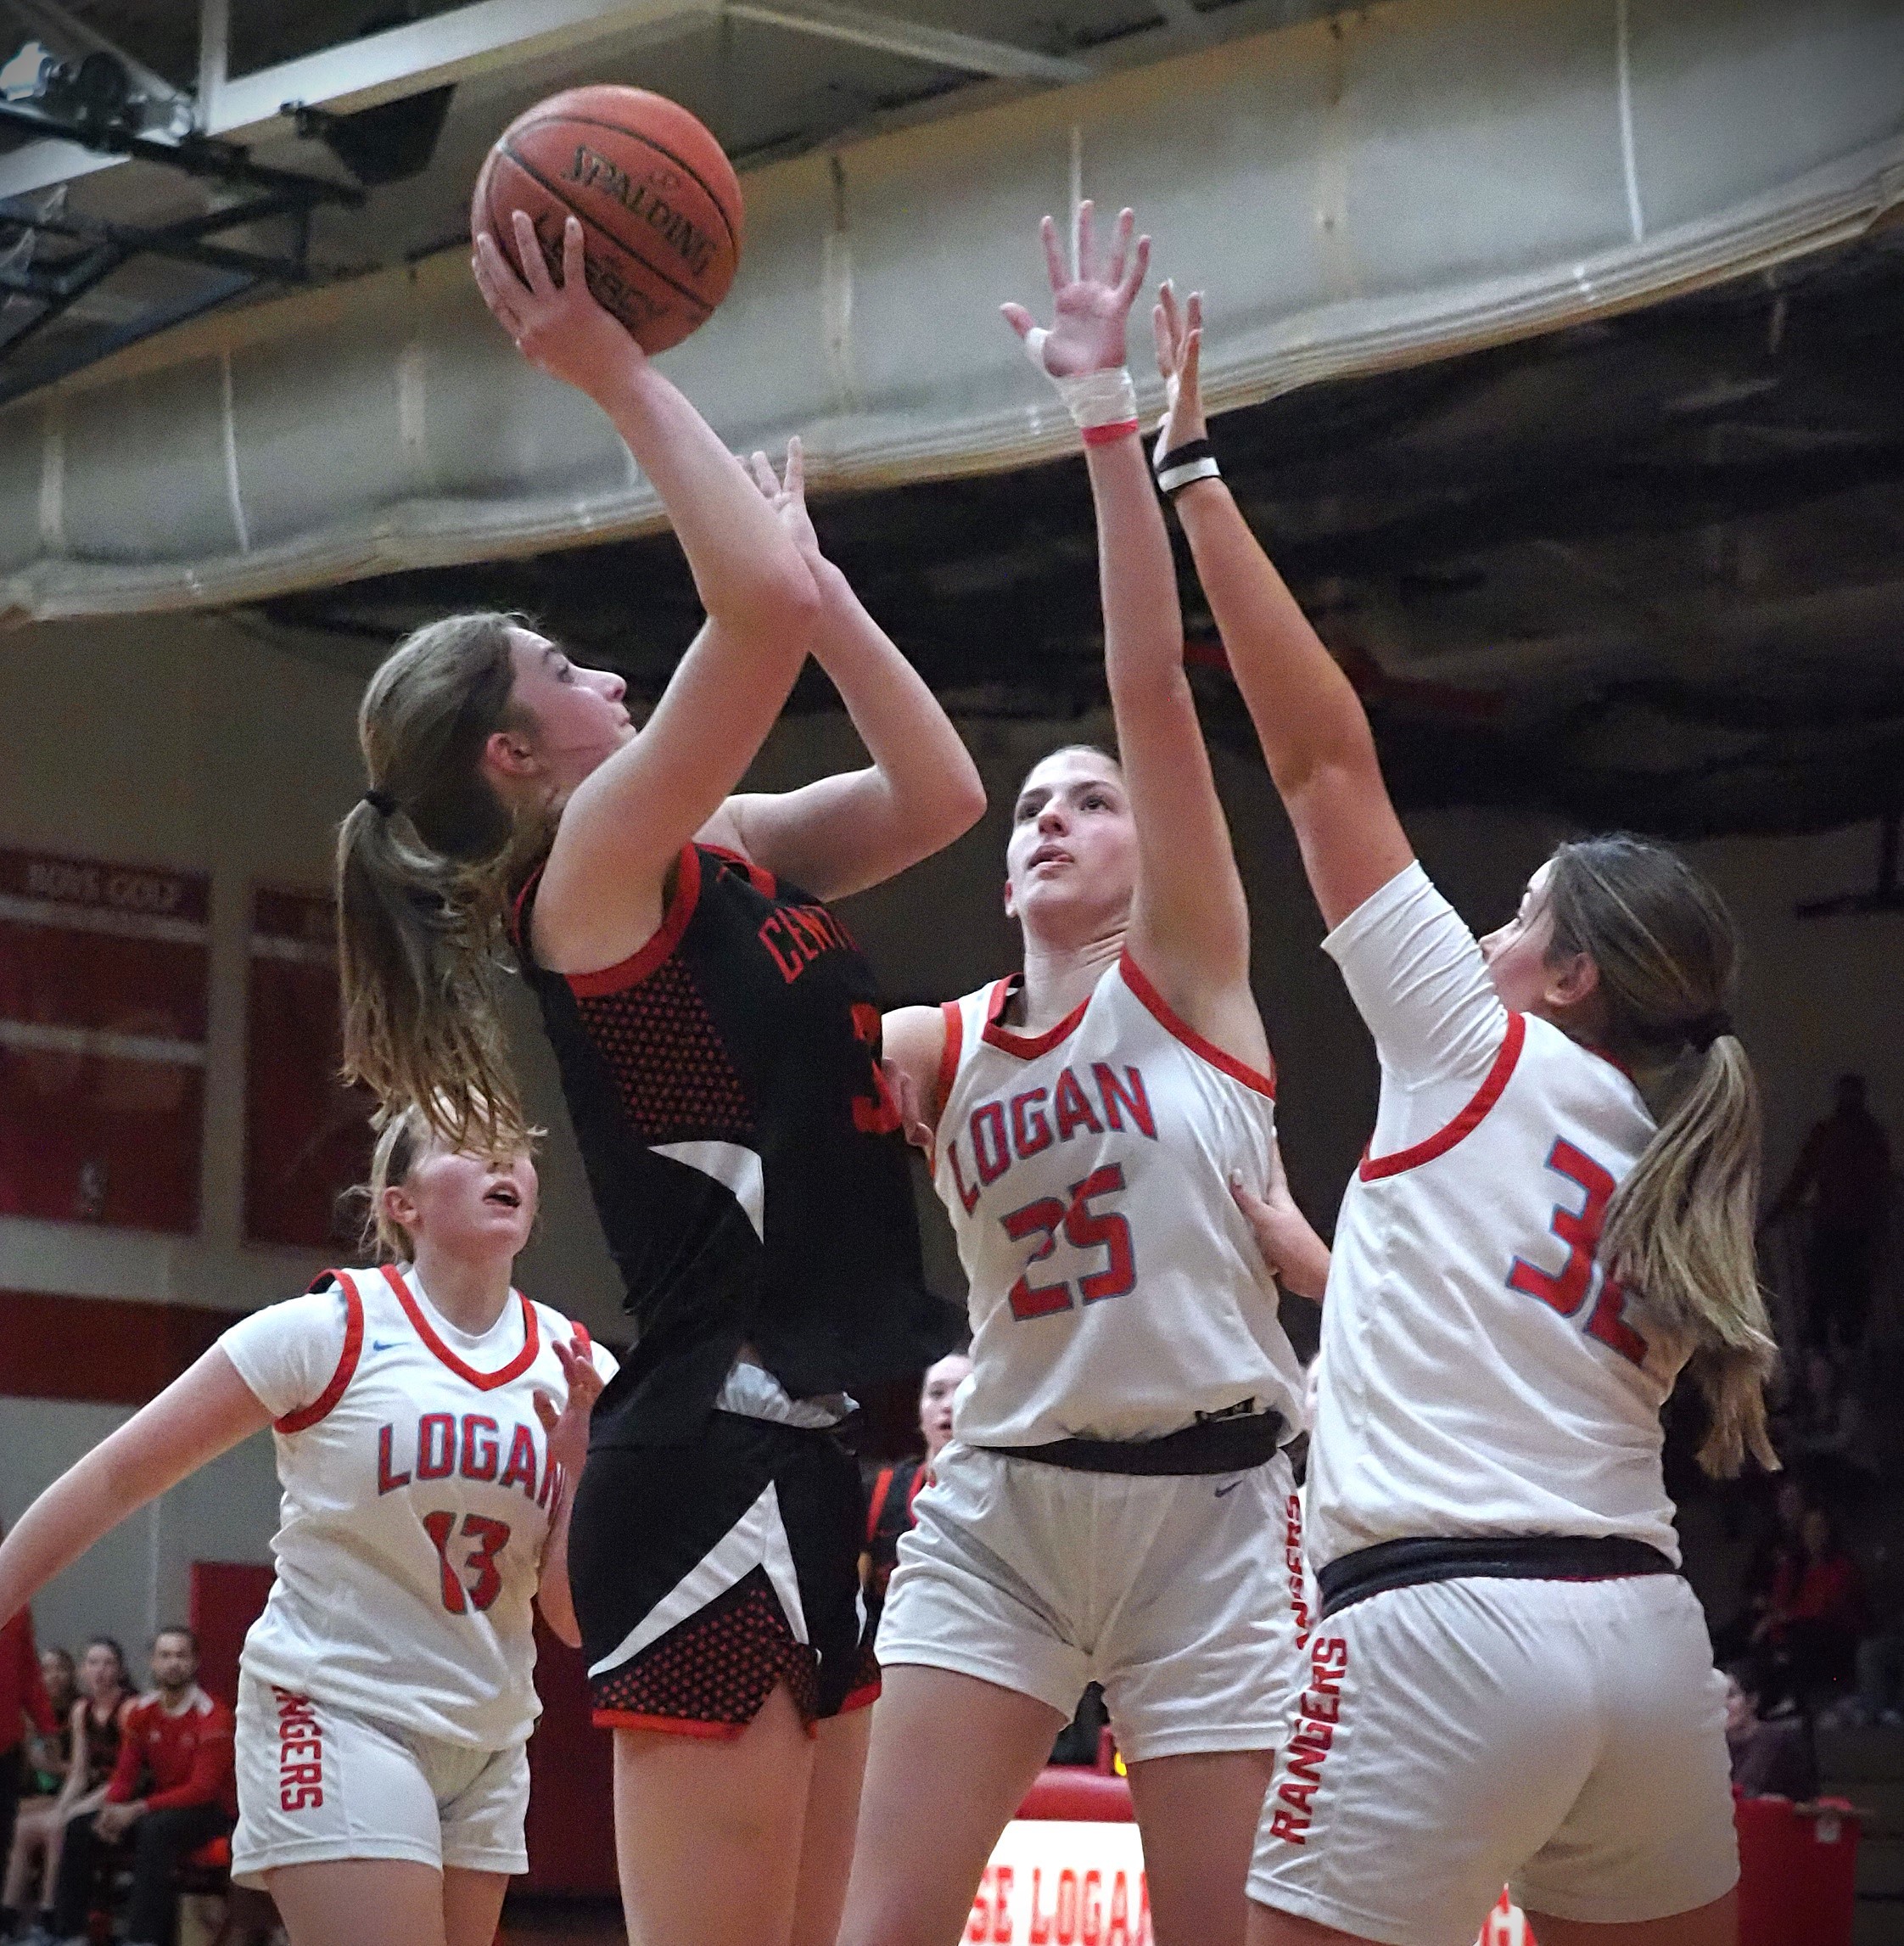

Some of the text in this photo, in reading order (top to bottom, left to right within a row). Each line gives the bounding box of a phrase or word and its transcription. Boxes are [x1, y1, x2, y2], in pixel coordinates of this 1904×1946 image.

[947, 1062, 1157, 1218] LOGAN
[999, 1162, 1137, 1321] 25
[423, 1510, 511, 1615] 13
[1269, 1637, 1348, 1845] RANGERS
